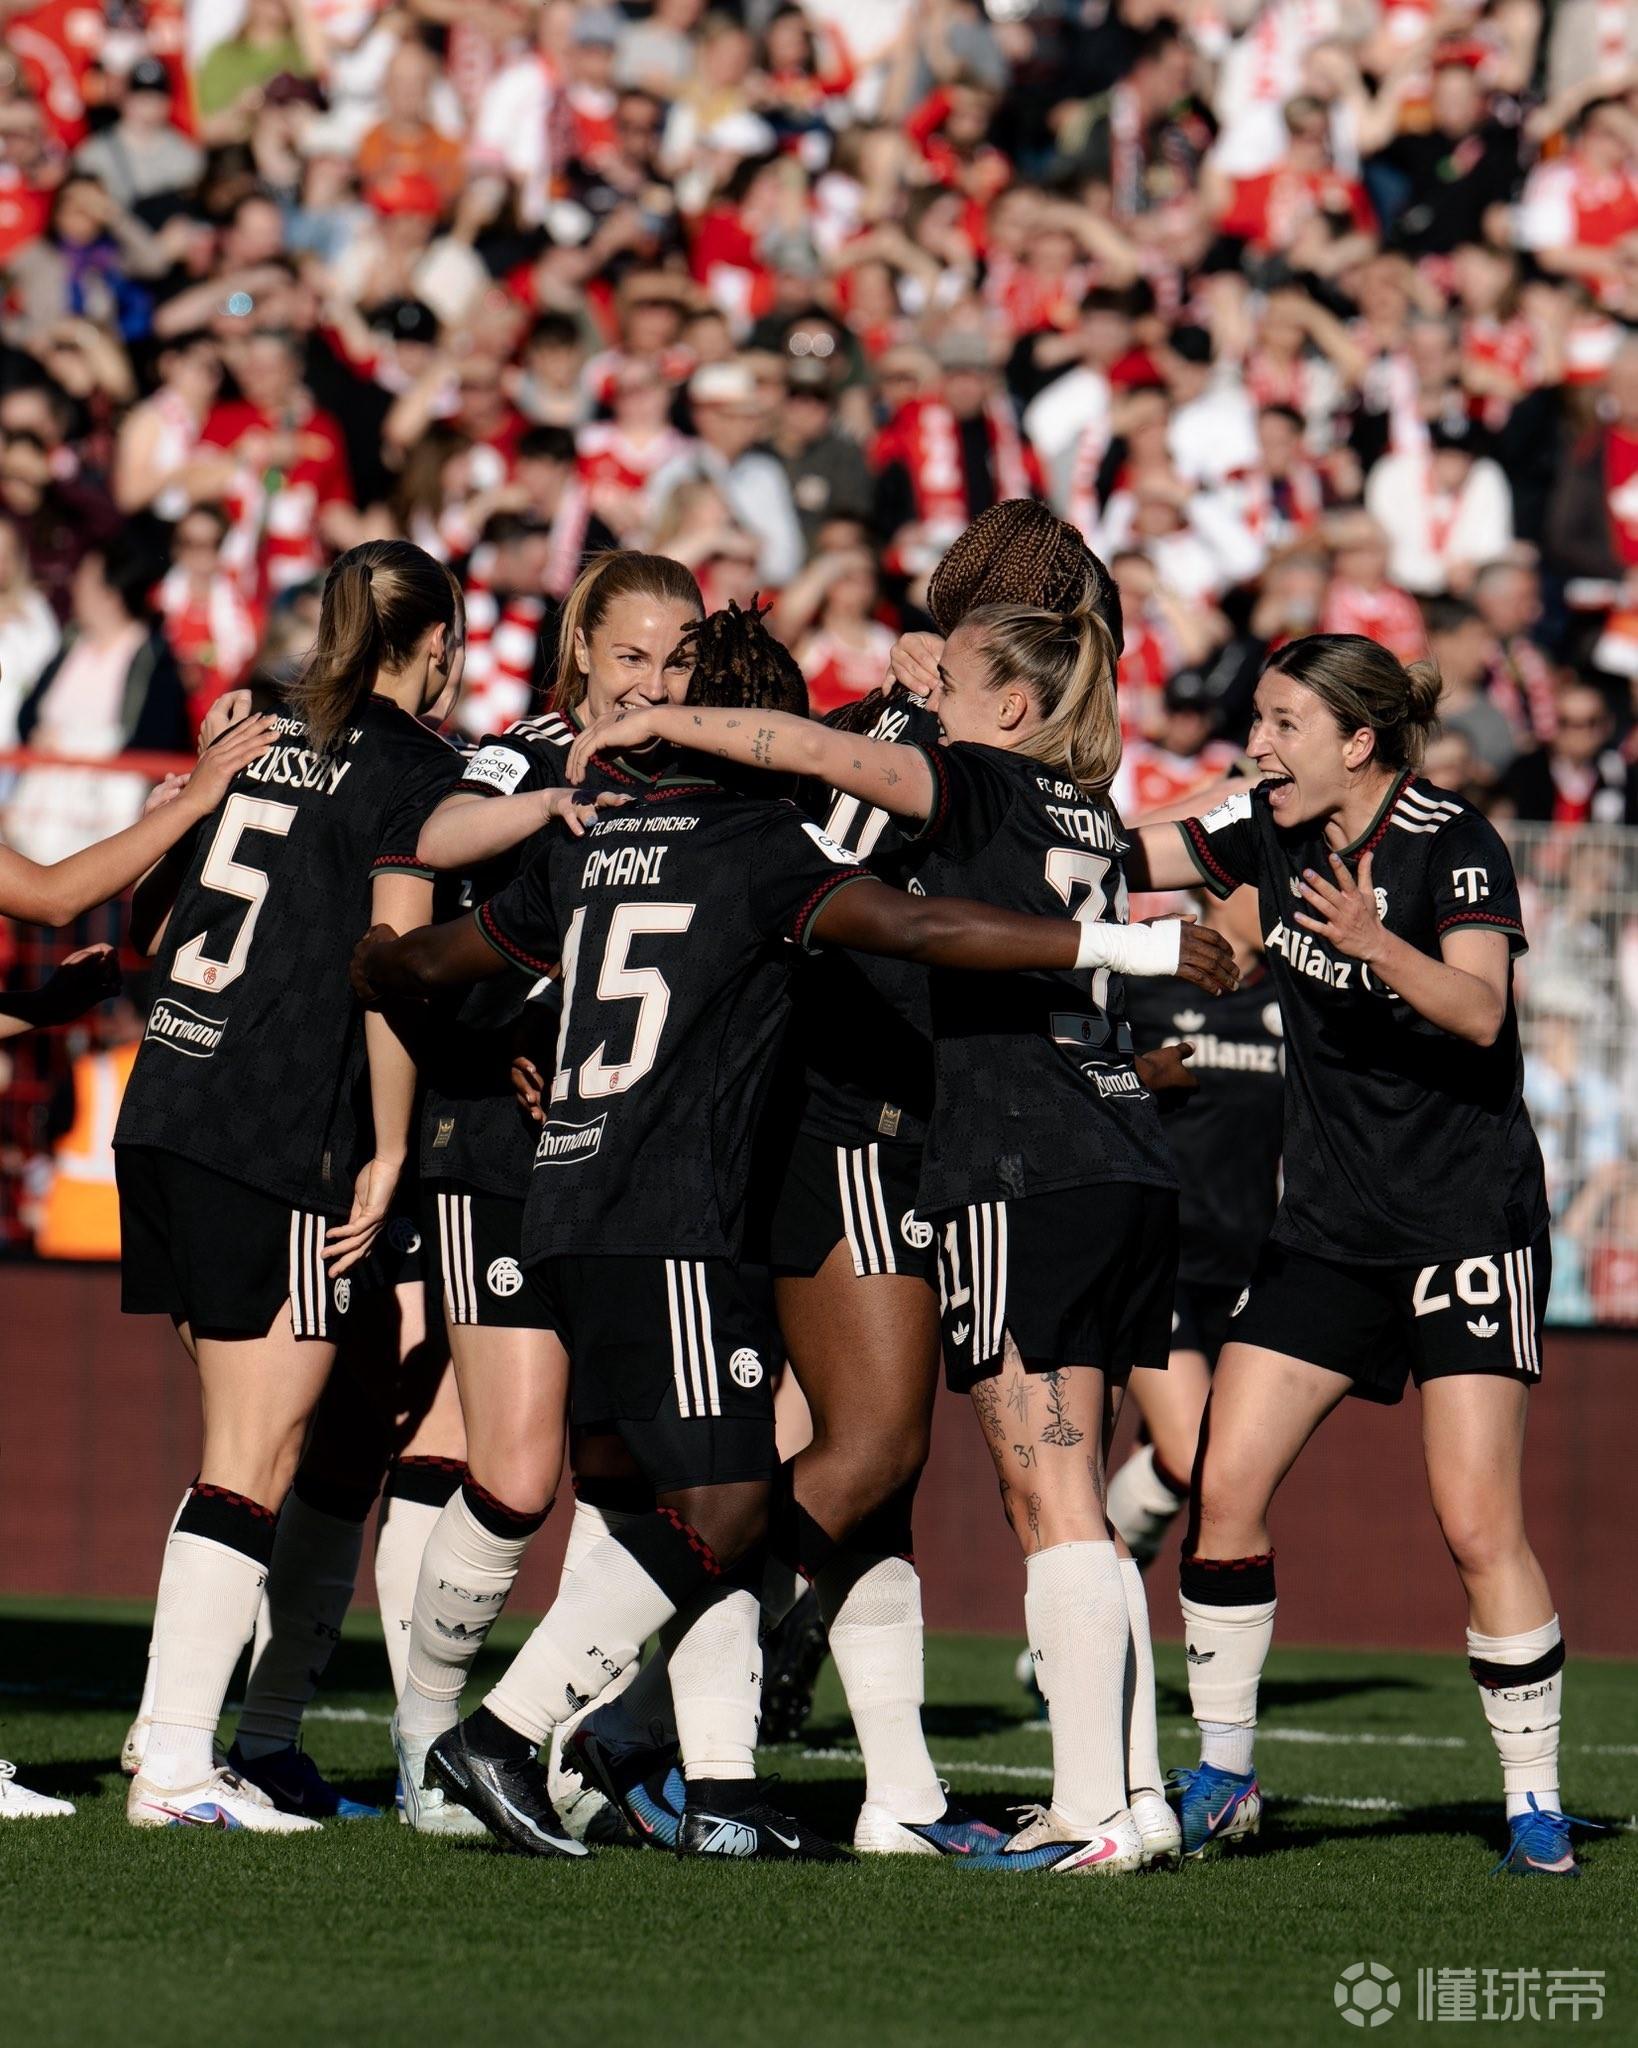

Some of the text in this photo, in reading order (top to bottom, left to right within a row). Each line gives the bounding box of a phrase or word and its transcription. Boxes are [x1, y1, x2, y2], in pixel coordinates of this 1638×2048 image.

[468, 767, 505, 783] Pixel
[602, 818, 642, 836] BAYERN
[642, 816, 700, 832] MÜNCHEN
[581, 846, 669, 889] AMANI
[1452, 866, 1490, 904] T
[171, 792, 299, 994] 5
[549, 902, 697, 1104] 15
[150, 1005, 222, 1049] Ehrmann
[536, 1127, 601, 1157] Ehrmann
